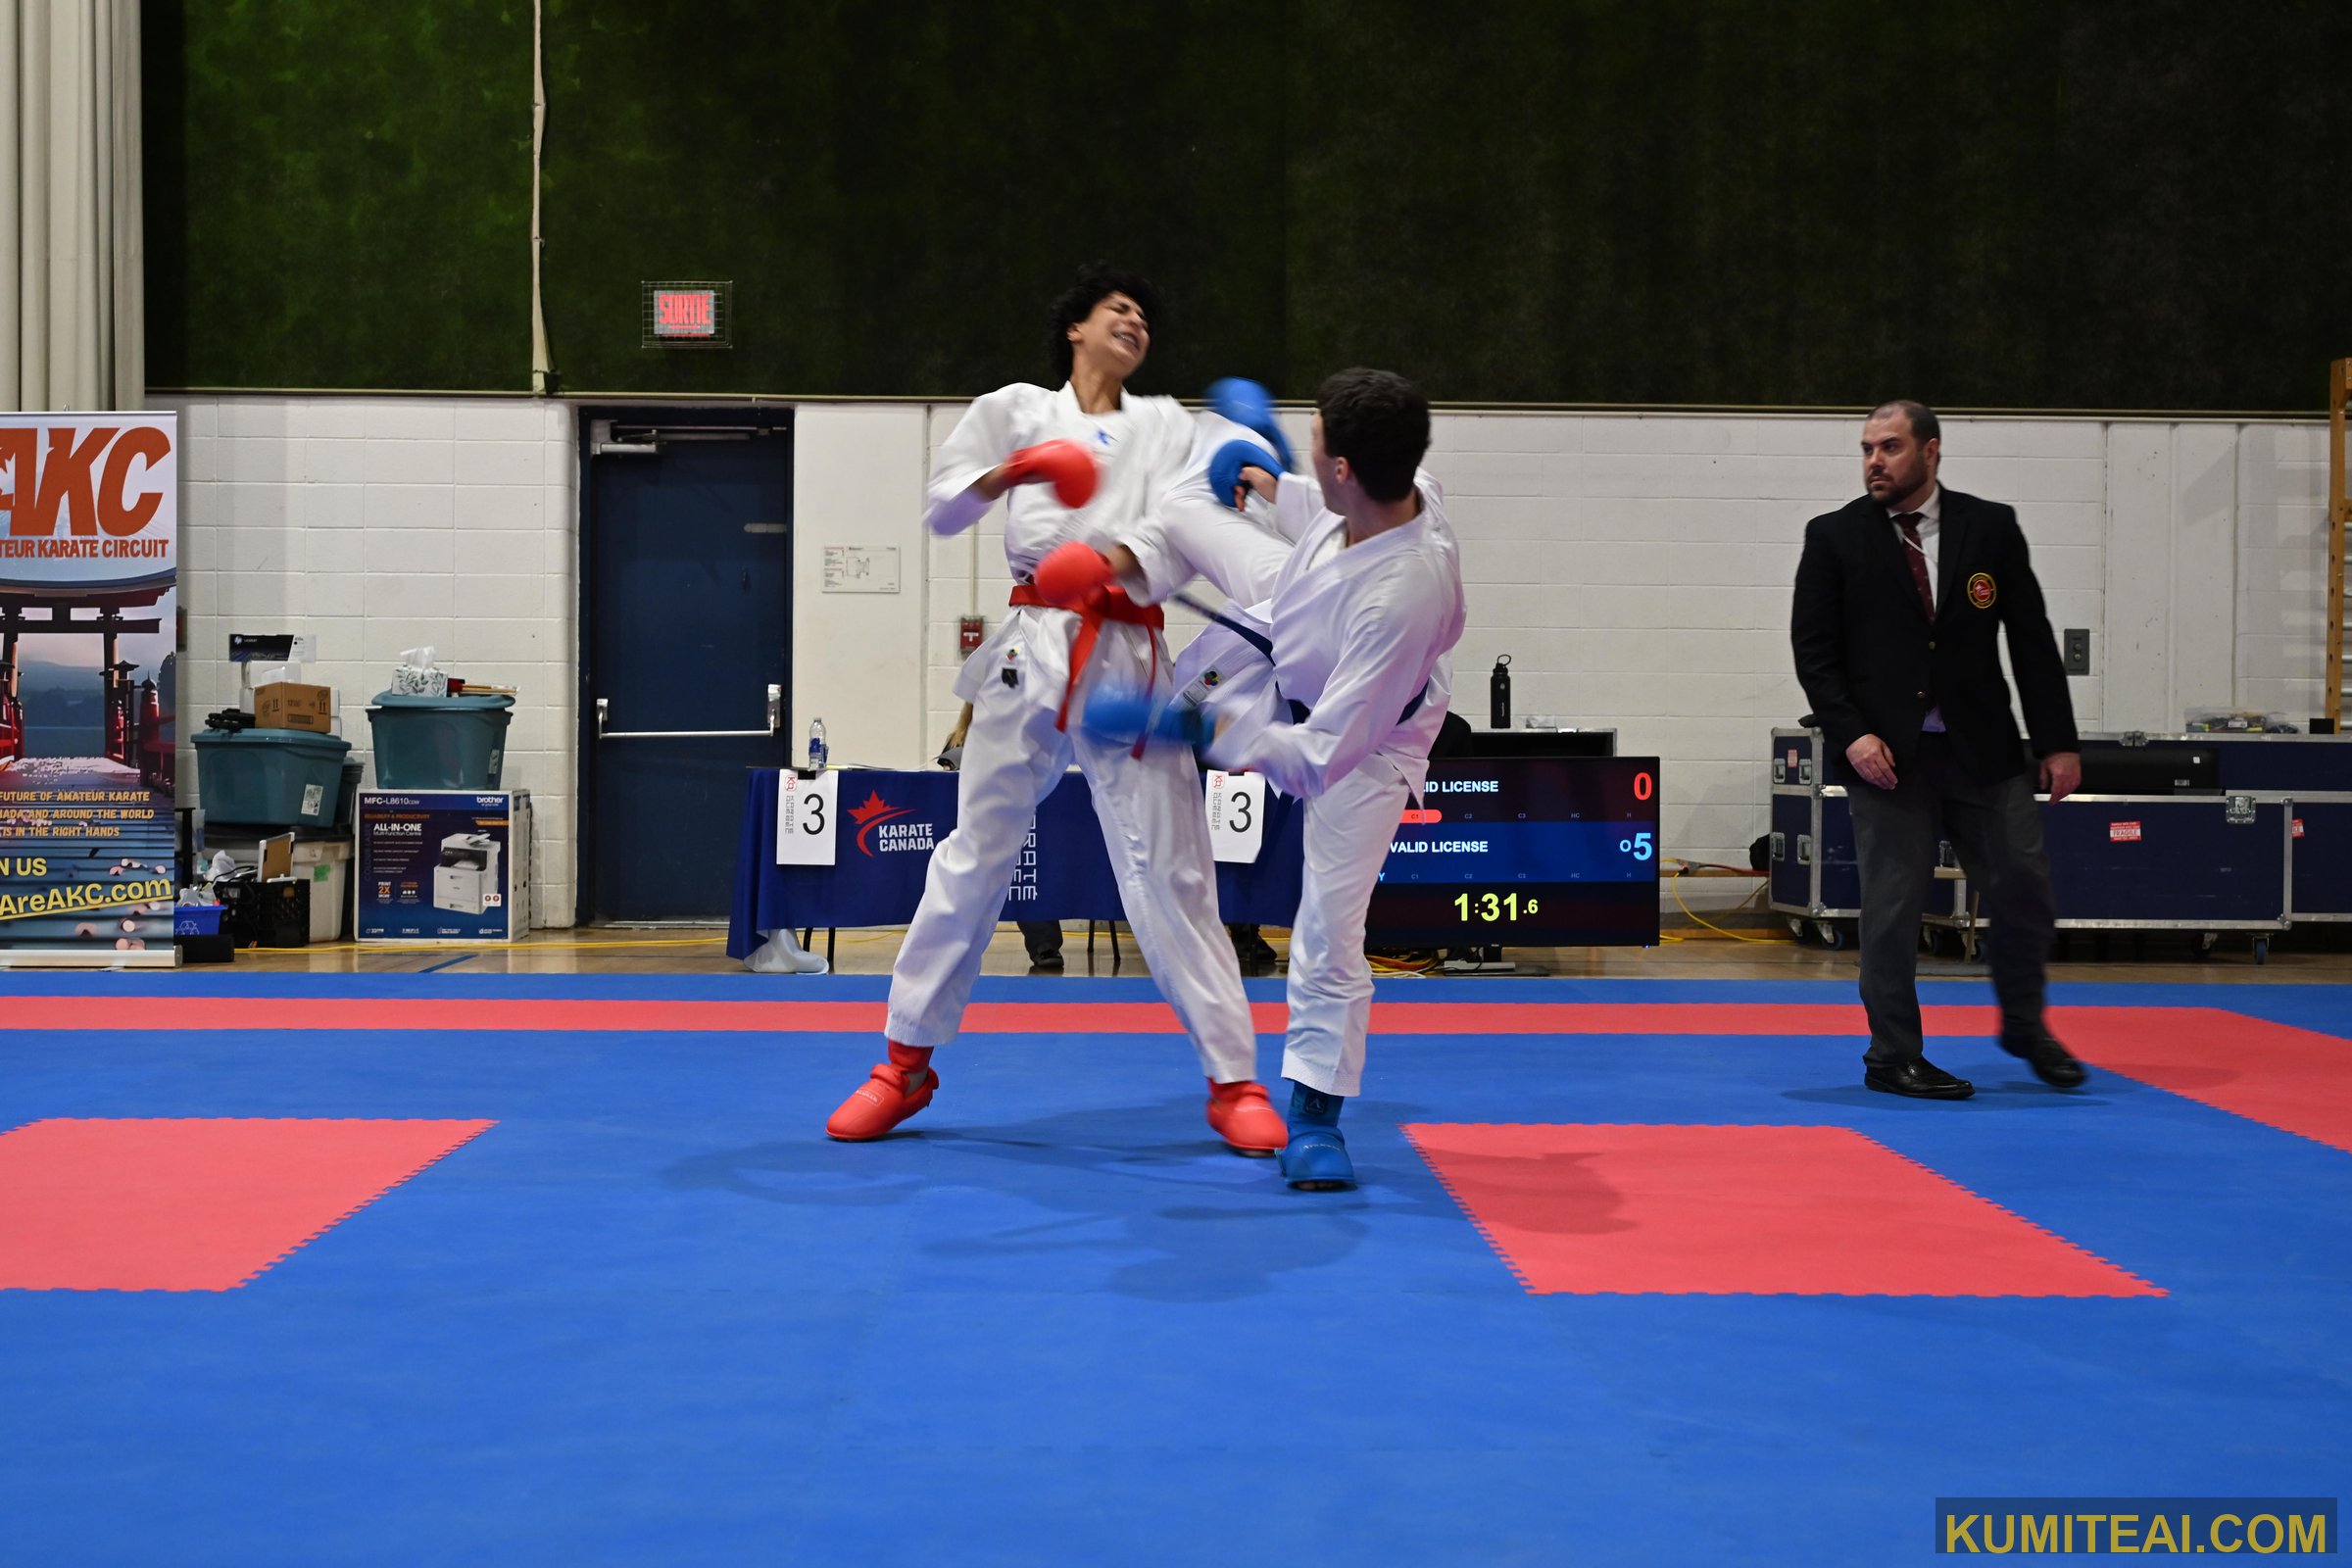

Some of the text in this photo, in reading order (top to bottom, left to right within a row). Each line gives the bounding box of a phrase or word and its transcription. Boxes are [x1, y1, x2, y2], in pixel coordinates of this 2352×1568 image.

[659, 293, 711, 324] SORTIE
[37, 539, 99, 558] KARATE
[102, 539, 170, 559] CIRCUIT
[1423, 781, 1498, 793] ID LICENSE
[1634, 771, 1652, 801] 0
[39, 791, 53, 802] OF
[56, 791, 105, 802] AMATEUR
[109, 791, 150, 802] KARATE
[28, 808, 49, 819] AND
[52, 808, 93, 819] AROUND
[97, 808, 117, 819] THE
[120, 808, 155, 819] WORLD
[803, 793, 825, 835] 3
[1229, 791, 1251, 833] 3
[3, 826, 121, 837] IS IN THE RIGHT HANDS
[373, 822, 422, 832] ALL-IN-ONE
[878, 823, 933, 839] KARATE
[879, 837, 935, 852] CANADA
[1432, 841, 1489, 853] LICENSE
[16, 858, 47, 876] US
[0, 878, 172, 916] AreAKC.com
